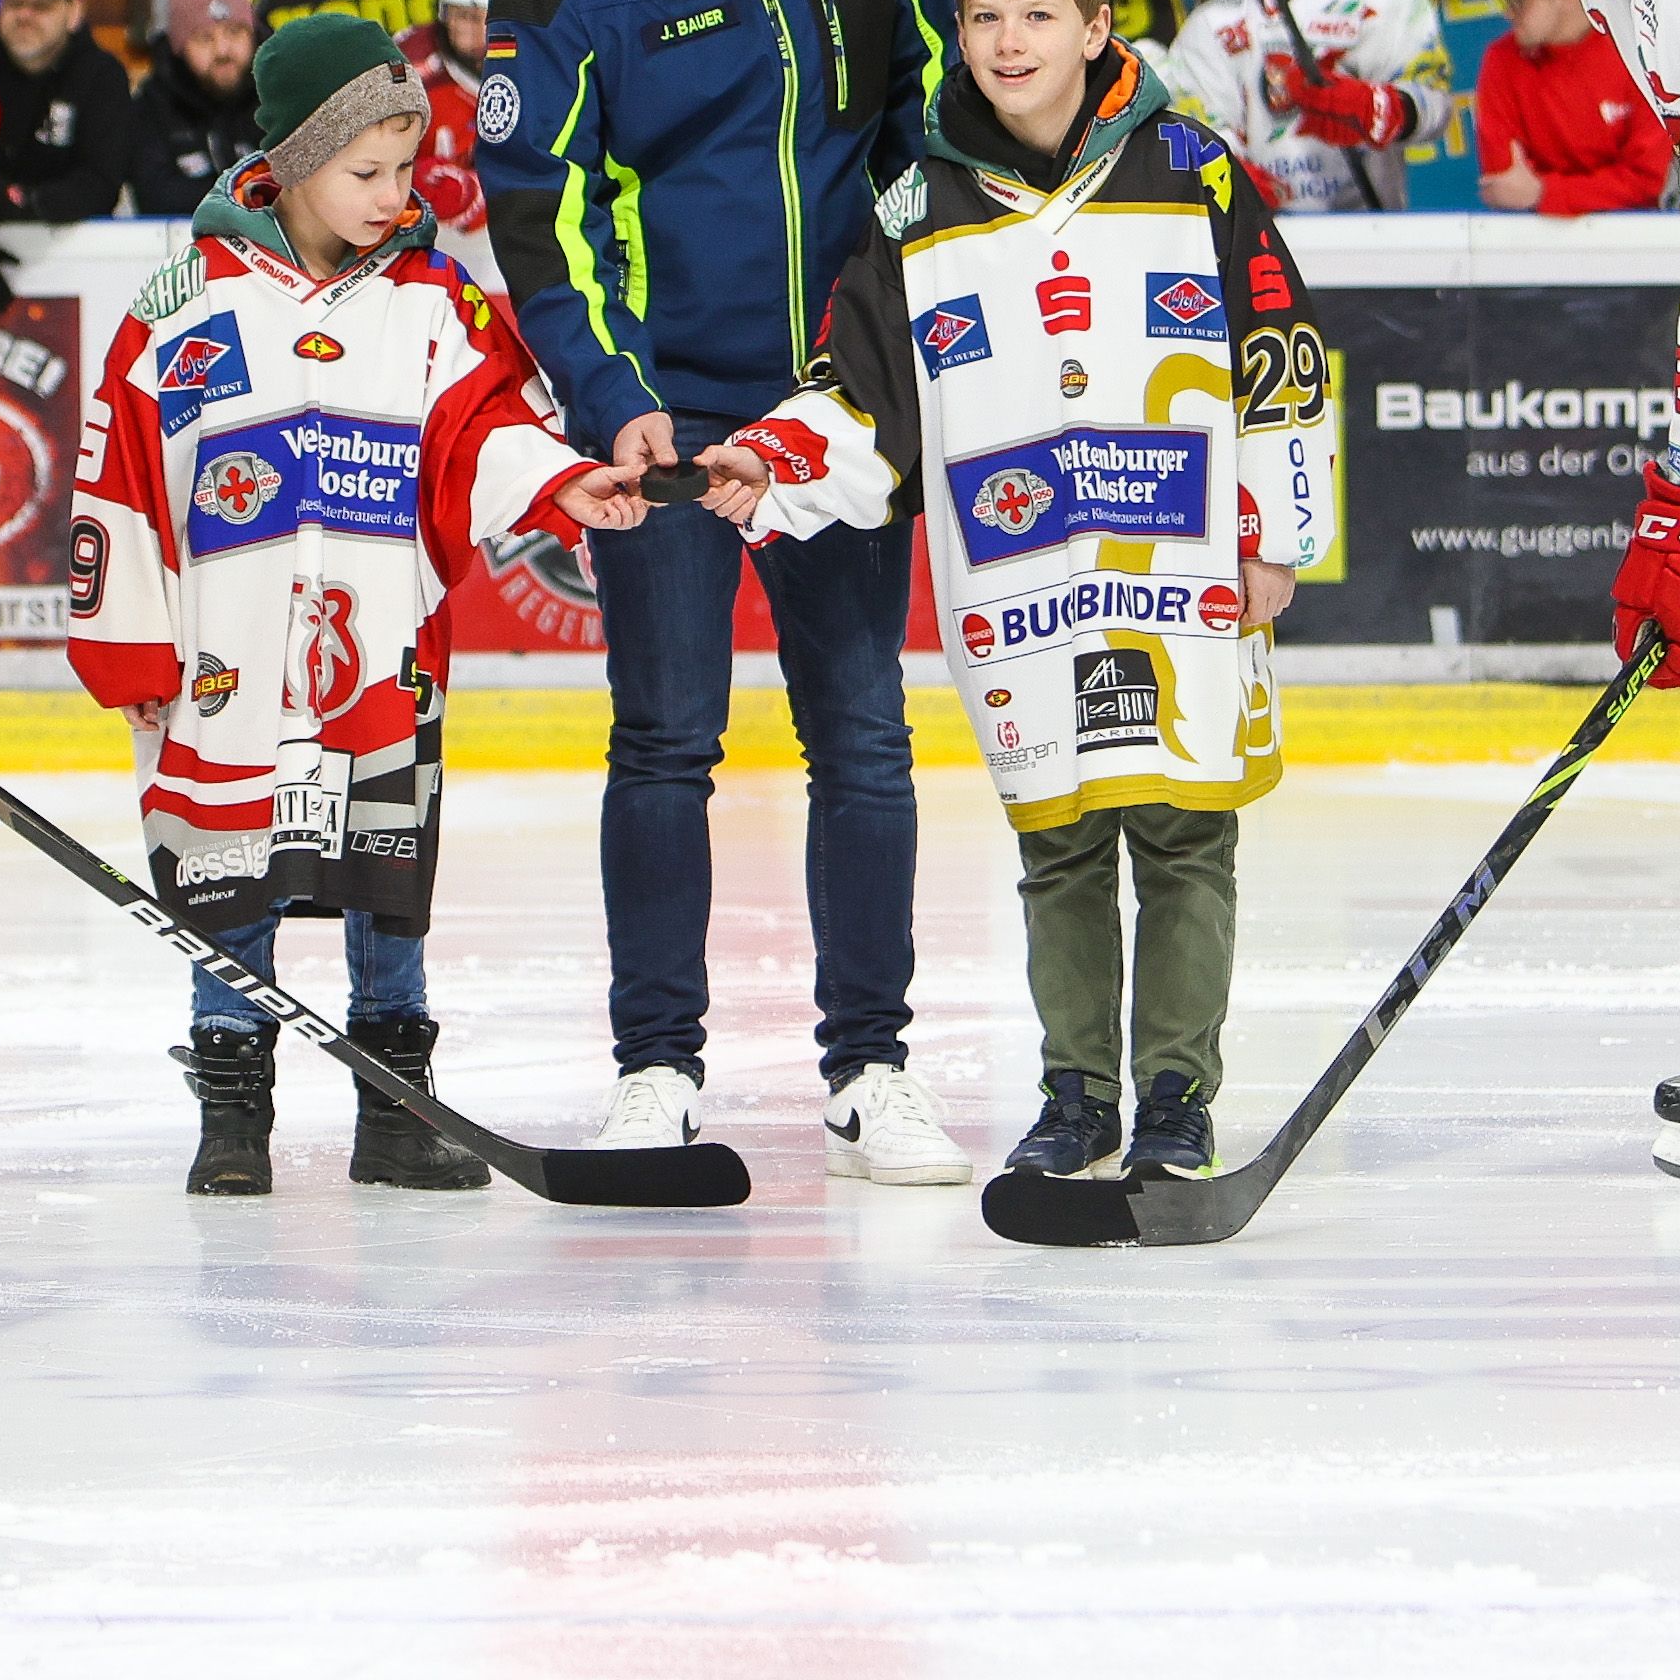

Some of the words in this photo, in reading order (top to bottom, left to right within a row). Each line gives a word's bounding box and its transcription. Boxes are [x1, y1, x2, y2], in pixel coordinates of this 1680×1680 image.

[659, 22, 675, 42] J.
[676, 8, 725, 40] BAUER
[321, 257, 381, 308] LANZINGER
[1239, 324, 1328, 432] 29
[316, 456, 402, 504] loster
[1050, 439, 1190, 481] Veltenburger
[1288, 437, 1314, 532] VDO
[1466, 450, 1529, 477] aus
[1538, 445, 1598, 477] der
[1072, 470, 1159, 505] Kloster
[393, 511, 416, 528] der
[1606, 641, 1666, 725] SUPER
[176, 835, 270, 887] dessig
[124, 897, 338, 1046] BAUER
